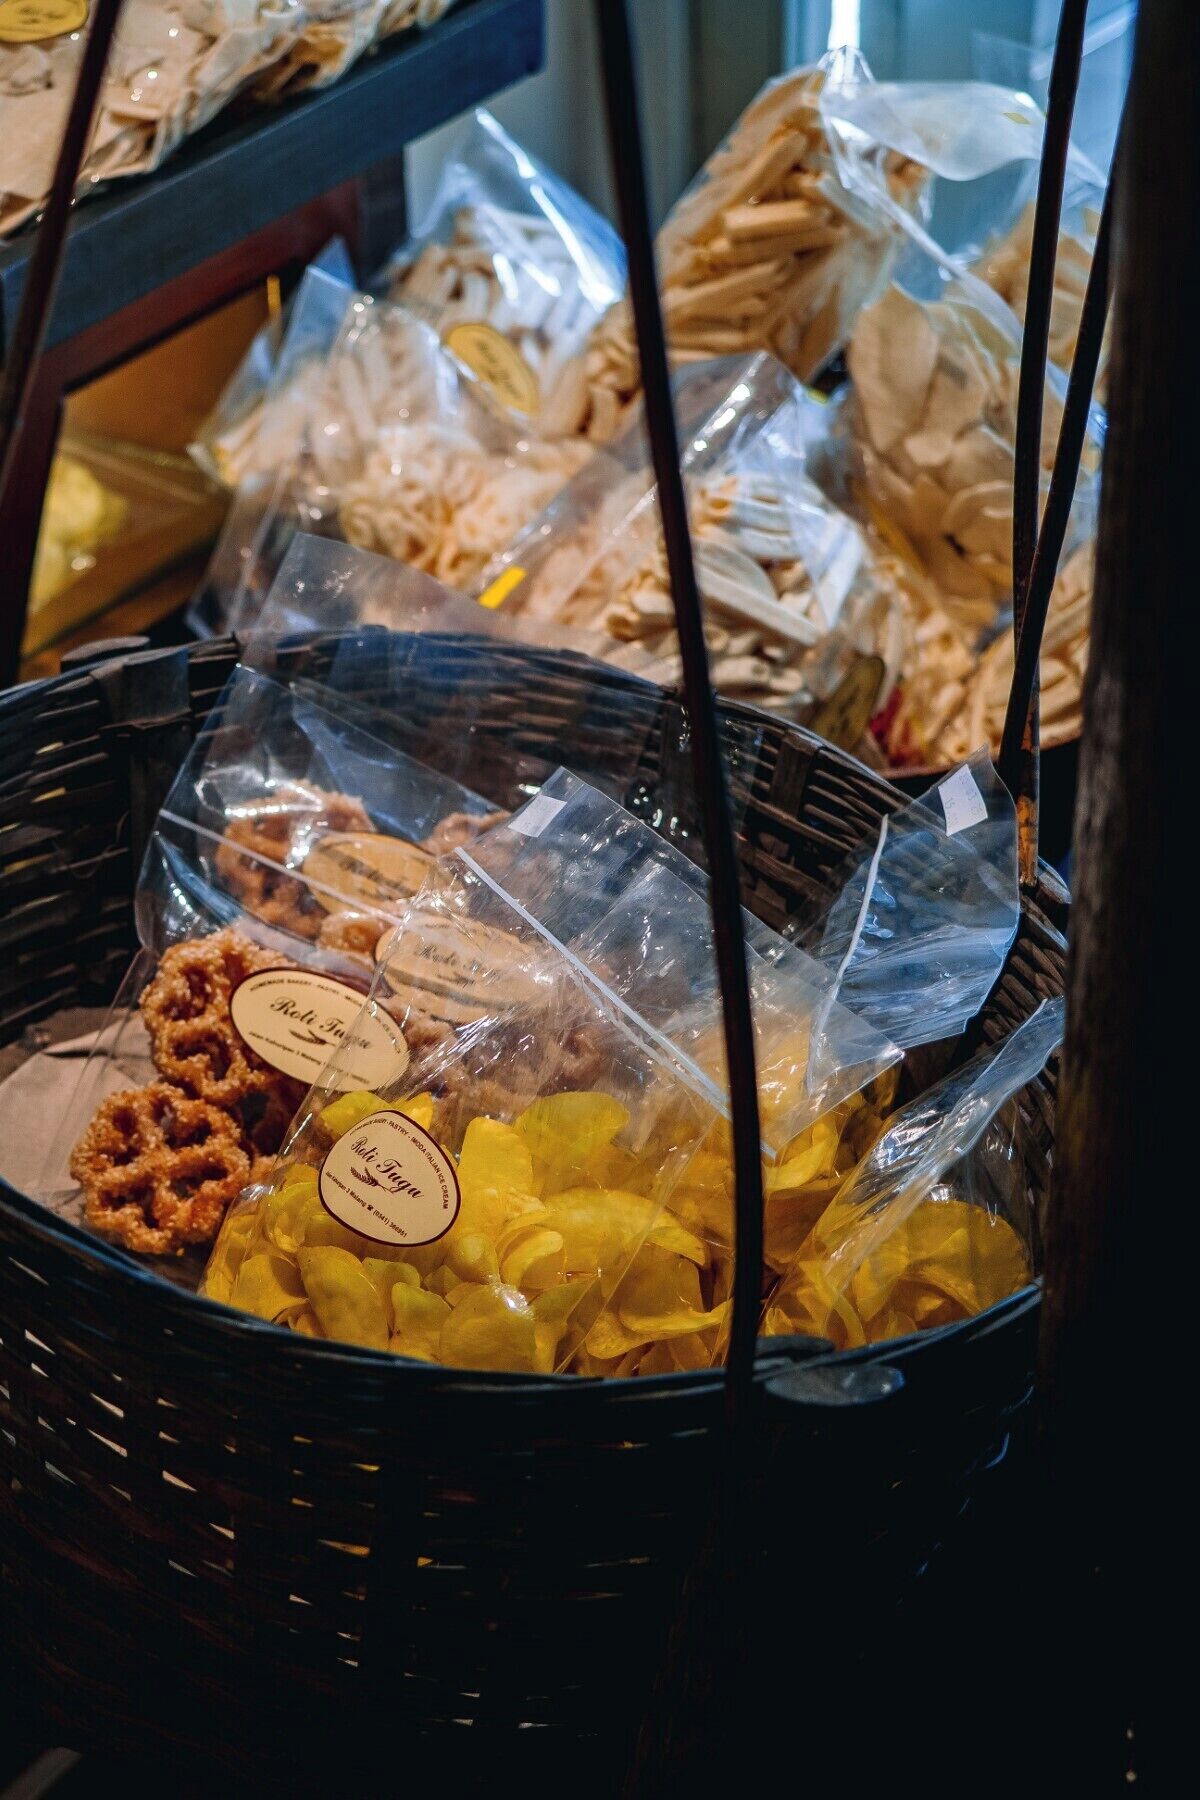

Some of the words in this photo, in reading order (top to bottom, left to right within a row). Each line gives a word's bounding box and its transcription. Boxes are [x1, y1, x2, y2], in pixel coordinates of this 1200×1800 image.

[270, 996, 317, 1025] Roti
[388, 1120, 409, 1136] PASTRY
[351, 1136, 378, 1162] Roti
[376, 1159, 424, 1198] Tugu
[424, 1151, 442, 1174] ITALIAN
[437, 1172, 446, 1185] ICE
[349, 1190, 367, 1208] Malang
[441, 1184, 449, 1209] CREAM
